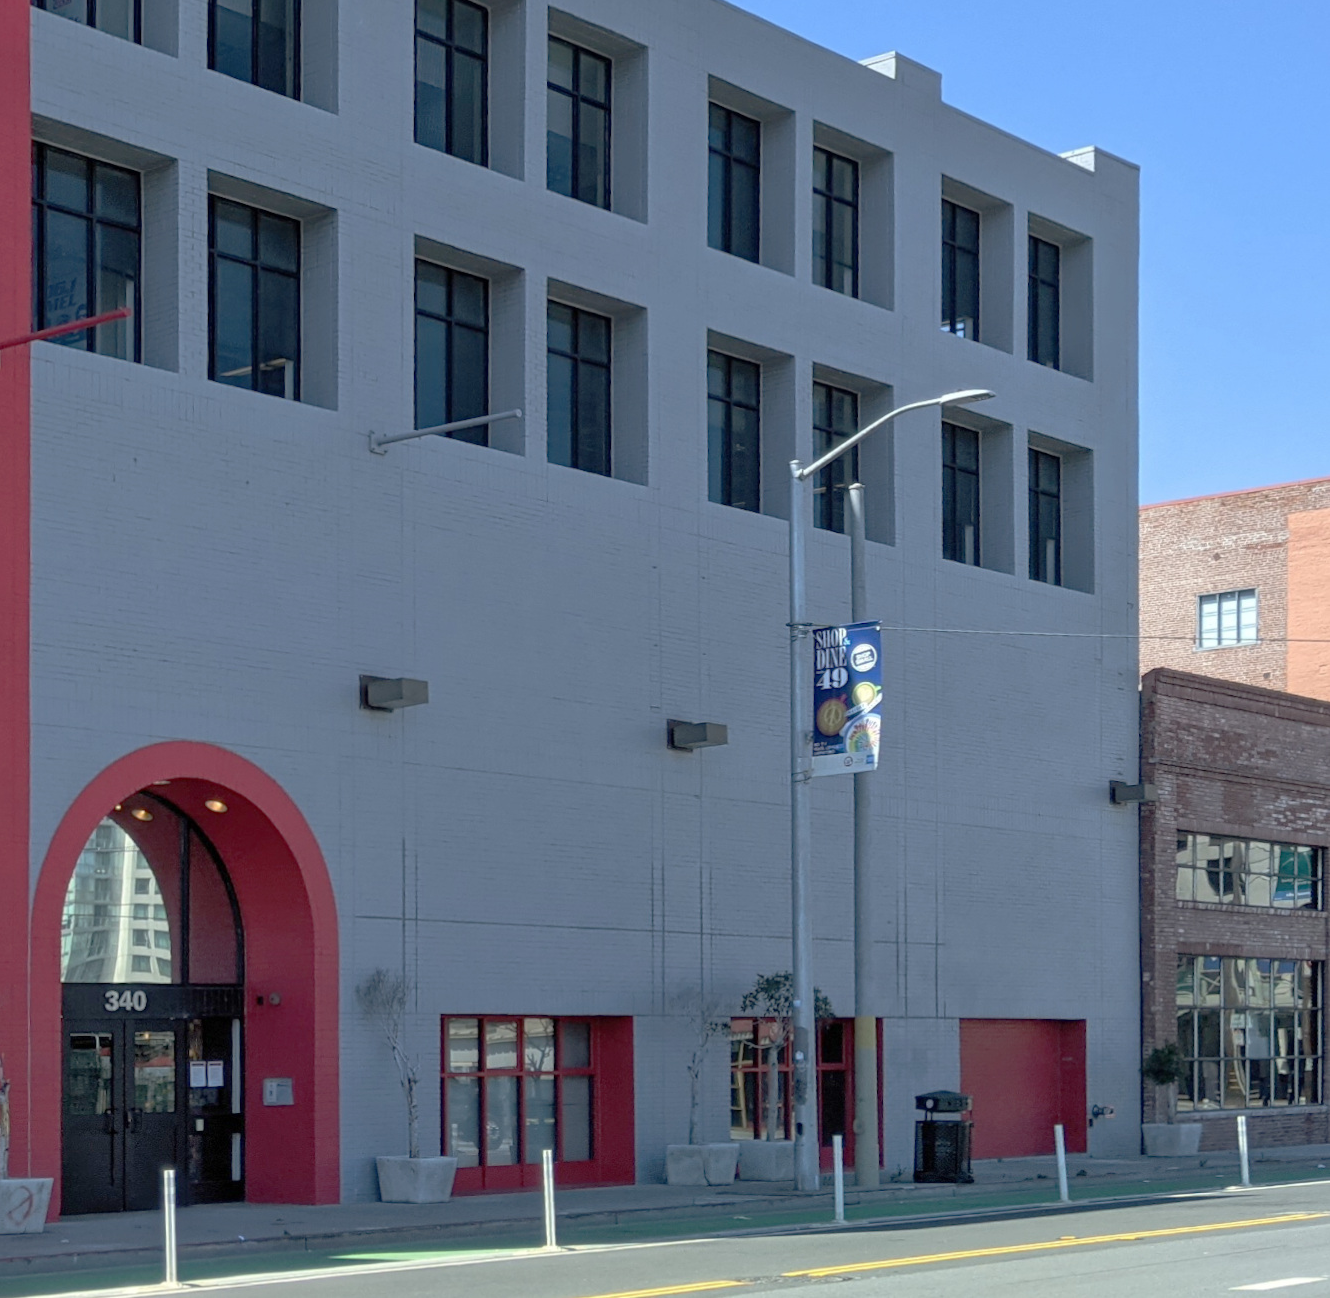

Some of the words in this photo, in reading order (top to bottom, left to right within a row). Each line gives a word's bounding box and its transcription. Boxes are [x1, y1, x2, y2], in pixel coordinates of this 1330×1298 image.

[816, 627, 847, 649] SHOP
[843, 637, 851, 645] &
[816, 646, 847, 670] DINE
[816, 667, 848, 690] 49
[104, 990, 147, 1012] 340
